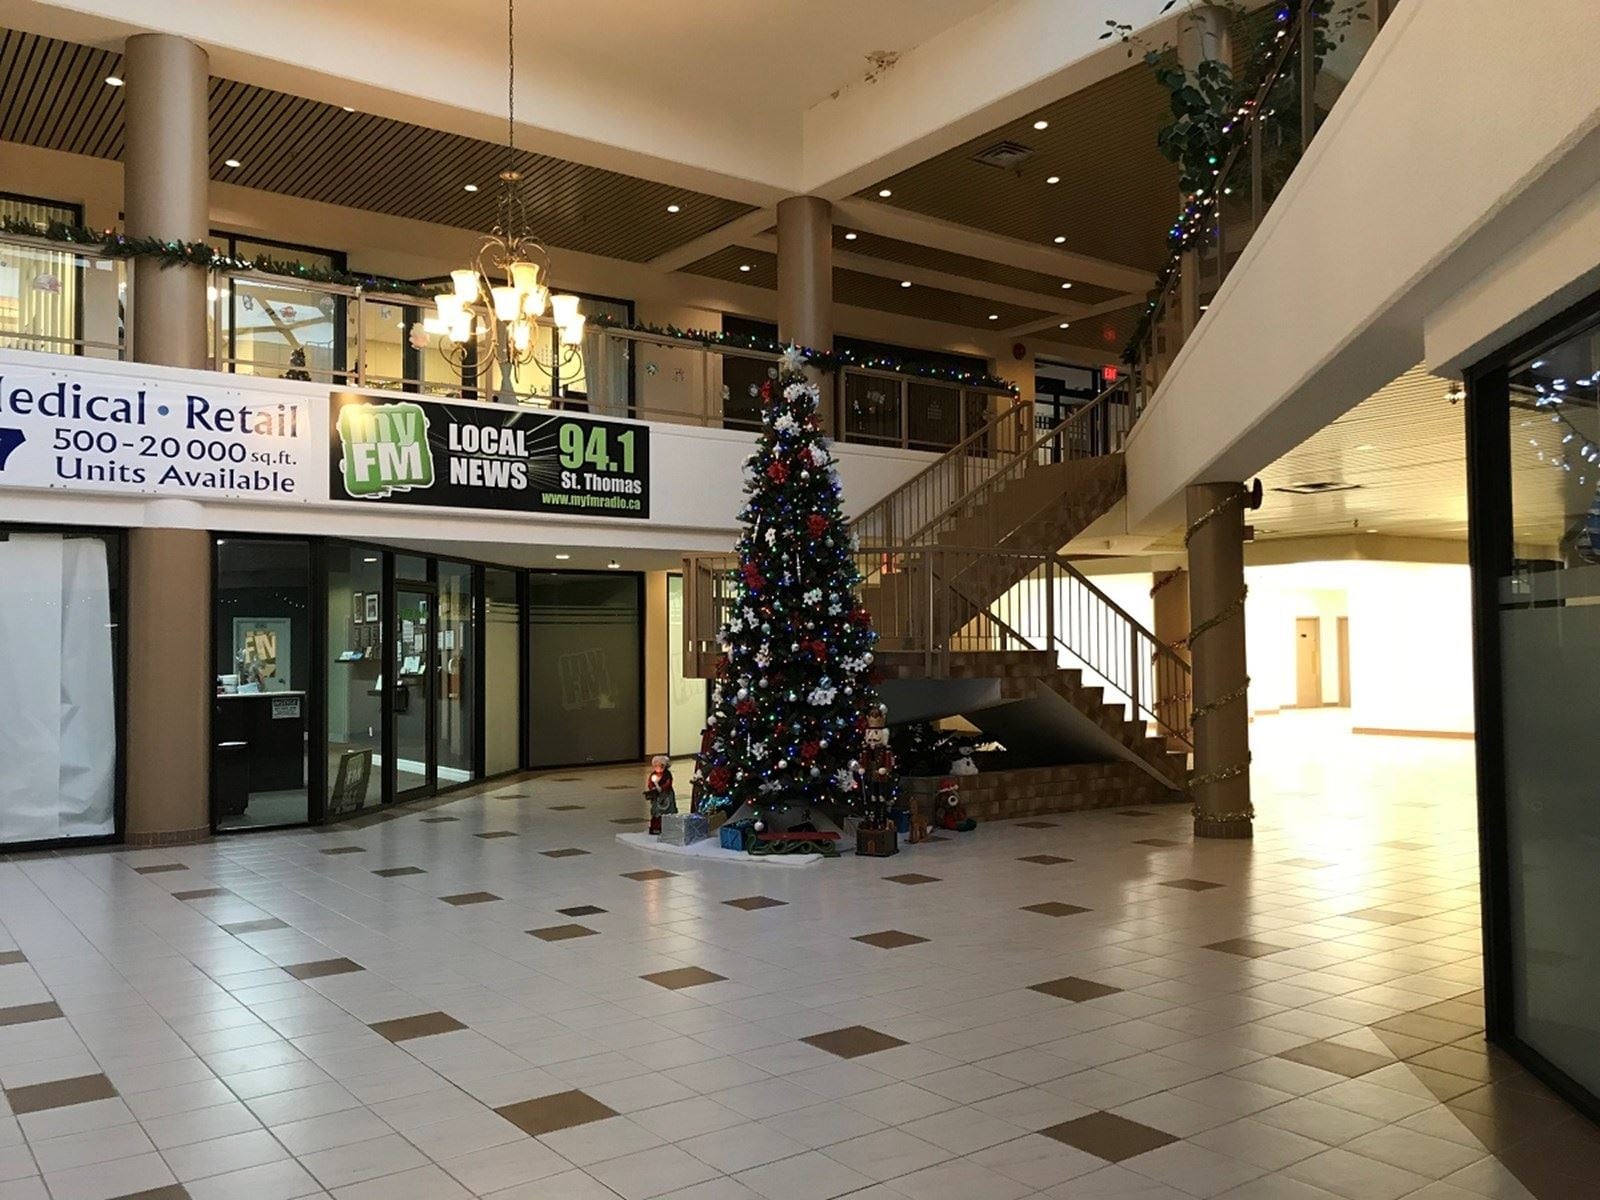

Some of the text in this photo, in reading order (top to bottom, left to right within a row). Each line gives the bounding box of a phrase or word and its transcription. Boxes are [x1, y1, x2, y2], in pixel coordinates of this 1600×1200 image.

[186, 395, 298, 438] Retail
[349, 409, 416, 447] my
[448, 423, 529, 457] LOCAL
[559, 422, 635, 474] 94.1
[56, 457, 295, 493] Units Available
[352, 442, 424, 482] FM
[449, 457, 528, 490] NEWS
[561, 471, 642, 494] St. Thomas
[541, 492, 641, 511] www.myfmradio.ca
